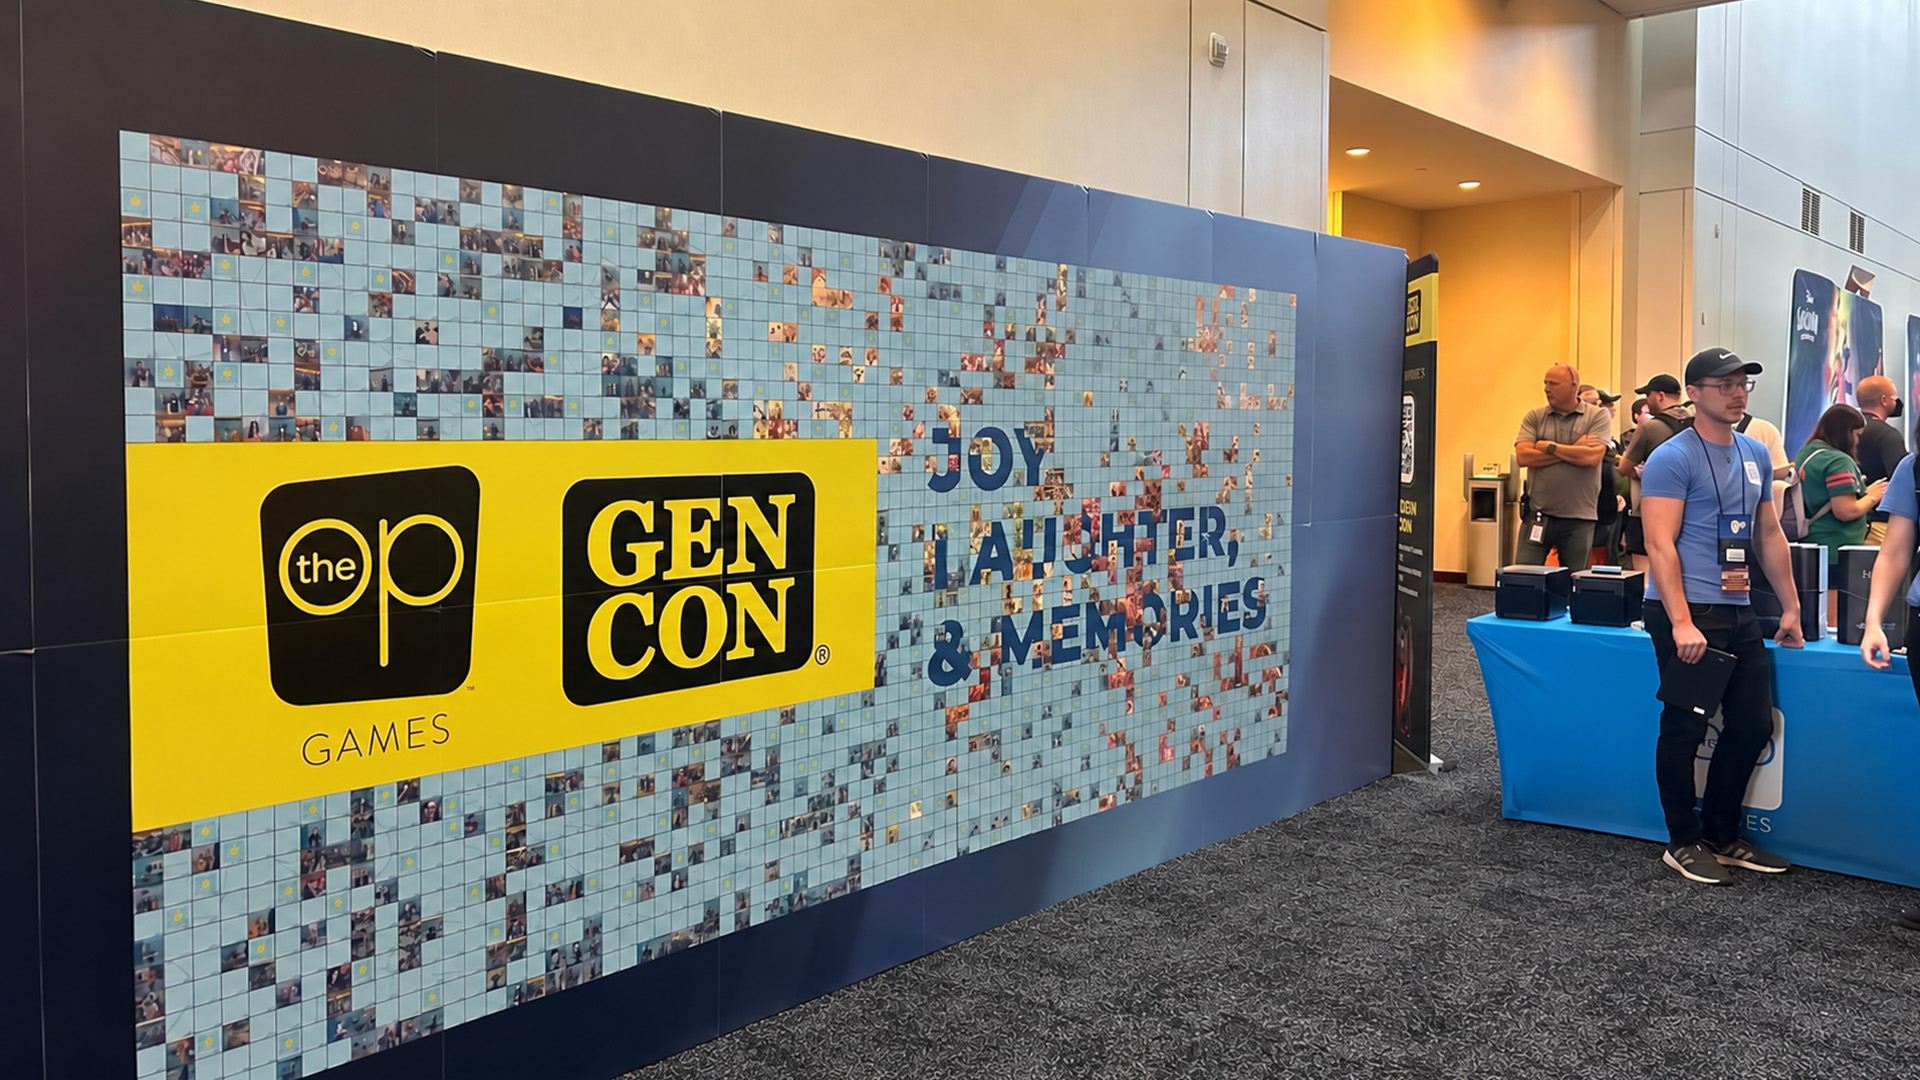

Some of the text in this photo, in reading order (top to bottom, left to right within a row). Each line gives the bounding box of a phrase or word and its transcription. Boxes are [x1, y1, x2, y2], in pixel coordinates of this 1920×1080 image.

[927, 426, 1050, 493] JOY
[296, 552, 357, 583] the
[587, 493, 796, 588] GEN
[586, 576, 796, 681] CON
[927, 576, 1267, 687] & MEMORIES
[302, 713, 451, 767] GAMES
